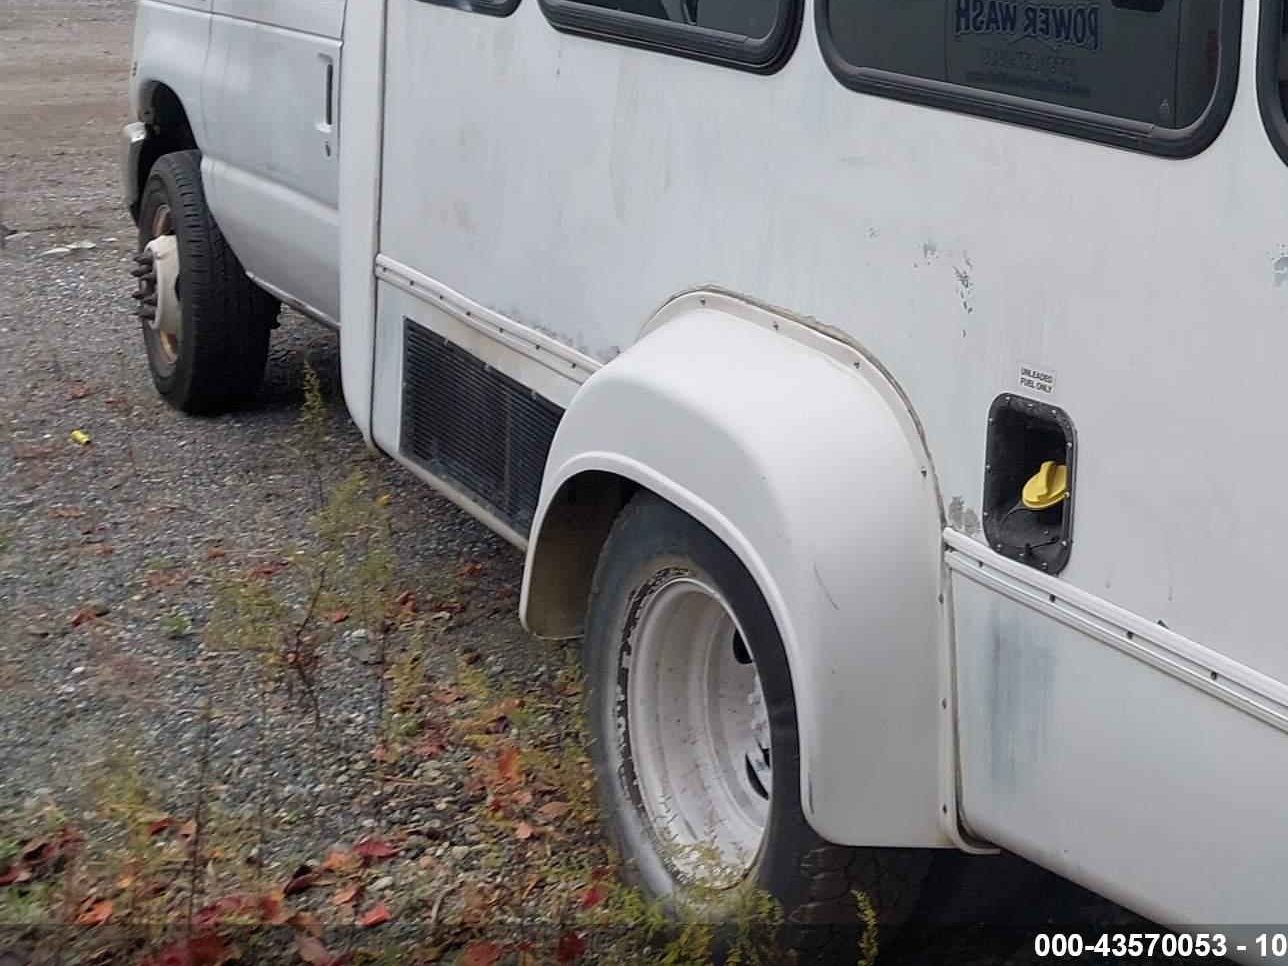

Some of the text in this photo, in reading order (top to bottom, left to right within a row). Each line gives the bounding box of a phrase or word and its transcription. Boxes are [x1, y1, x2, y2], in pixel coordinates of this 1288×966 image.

[1020, 367, 1052, 383] UNLEADED
[1020, 377, 1052, 393] FUEL ONLY
